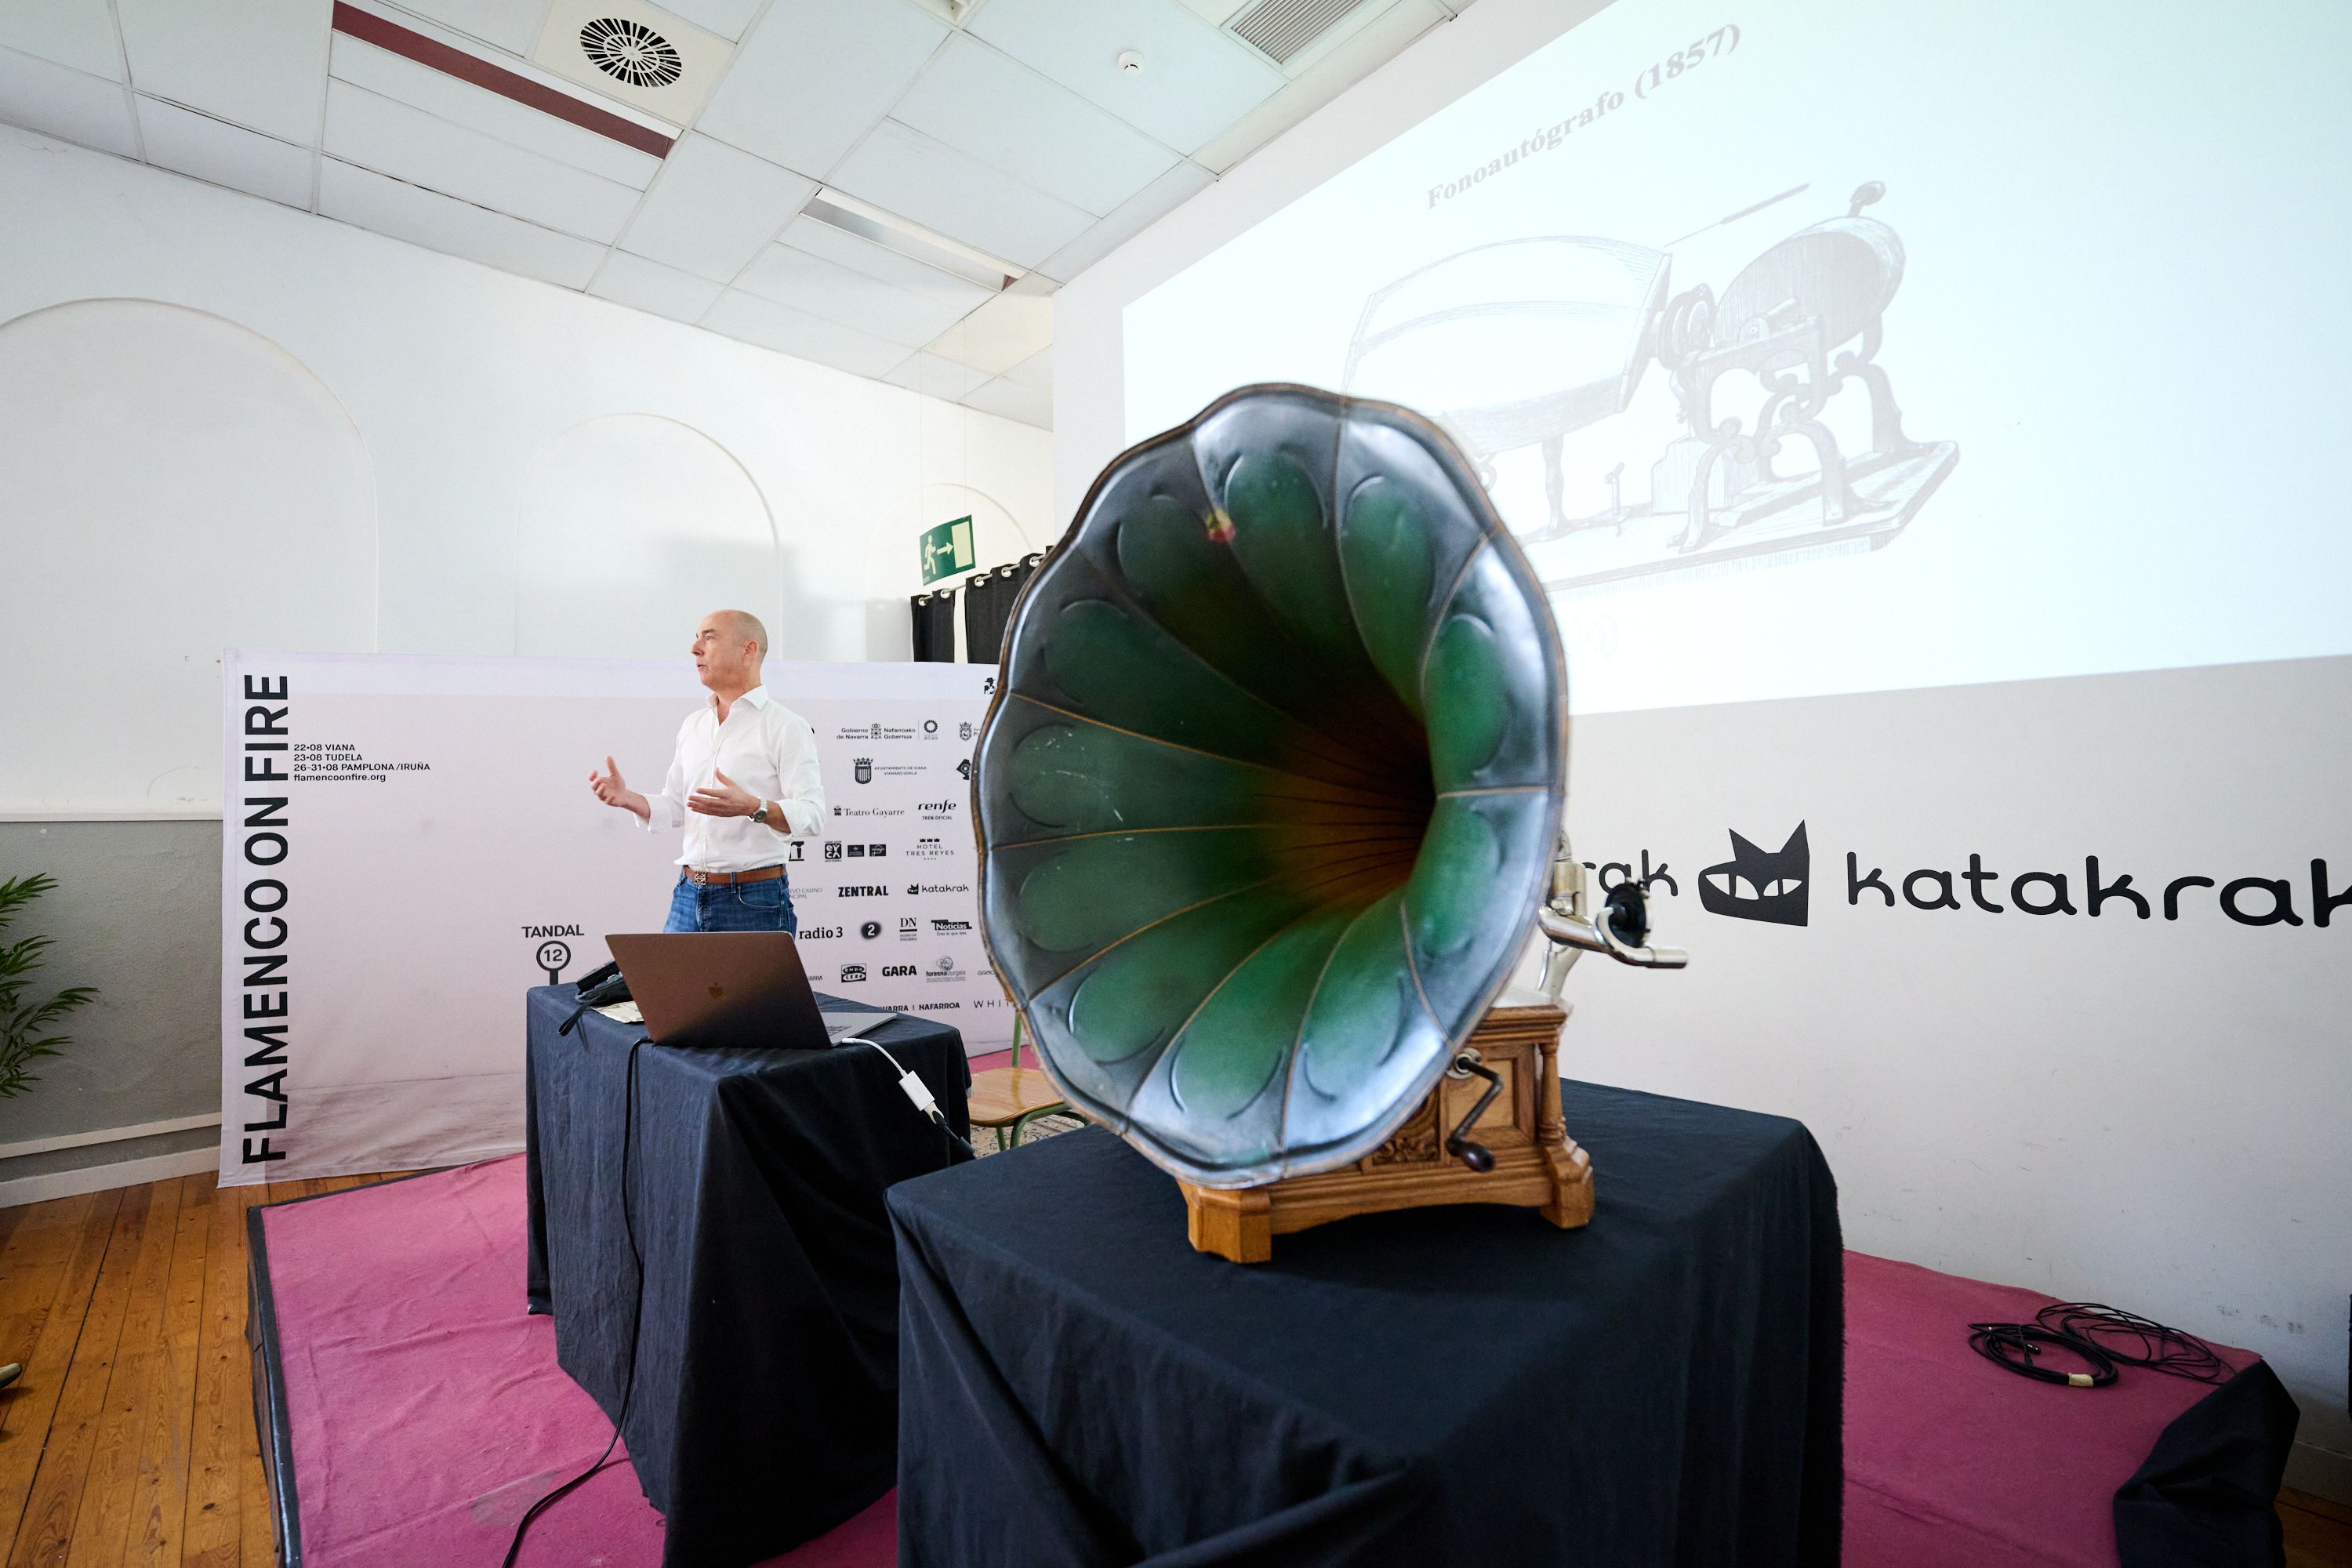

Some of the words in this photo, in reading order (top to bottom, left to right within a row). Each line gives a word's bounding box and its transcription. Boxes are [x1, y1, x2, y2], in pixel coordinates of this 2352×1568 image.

[1426, 89, 1625, 209] Fonoautógrafo
[1633, 23, 1742, 100] (1857)
[244, 674, 289, 781] FIRE
[294, 773, 387, 782] flamencoonfire.org
[918, 799, 956, 814] renfe
[873, 808, 905, 818] Gayarre
[244, 797, 289, 866] ON
[838, 885, 889, 898] ZENTRAL
[921, 884, 969, 893] katakrak
[1847, 851, 2352, 927] katakrak
[900, 917, 916, 927] DN
[936, 921, 967, 930] Noticias
[521, 924, 584, 938] TANDAL
[799, 927, 833, 939] radio
[836, 927, 843, 938] 3
[867, 924, 875, 936] 2
[544, 949, 563, 962] 12
[882, 965, 917, 977] GARA
[919, 1002, 960, 1011] NAFARROA
[242, 878, 289, 1164] FLAMENCO
